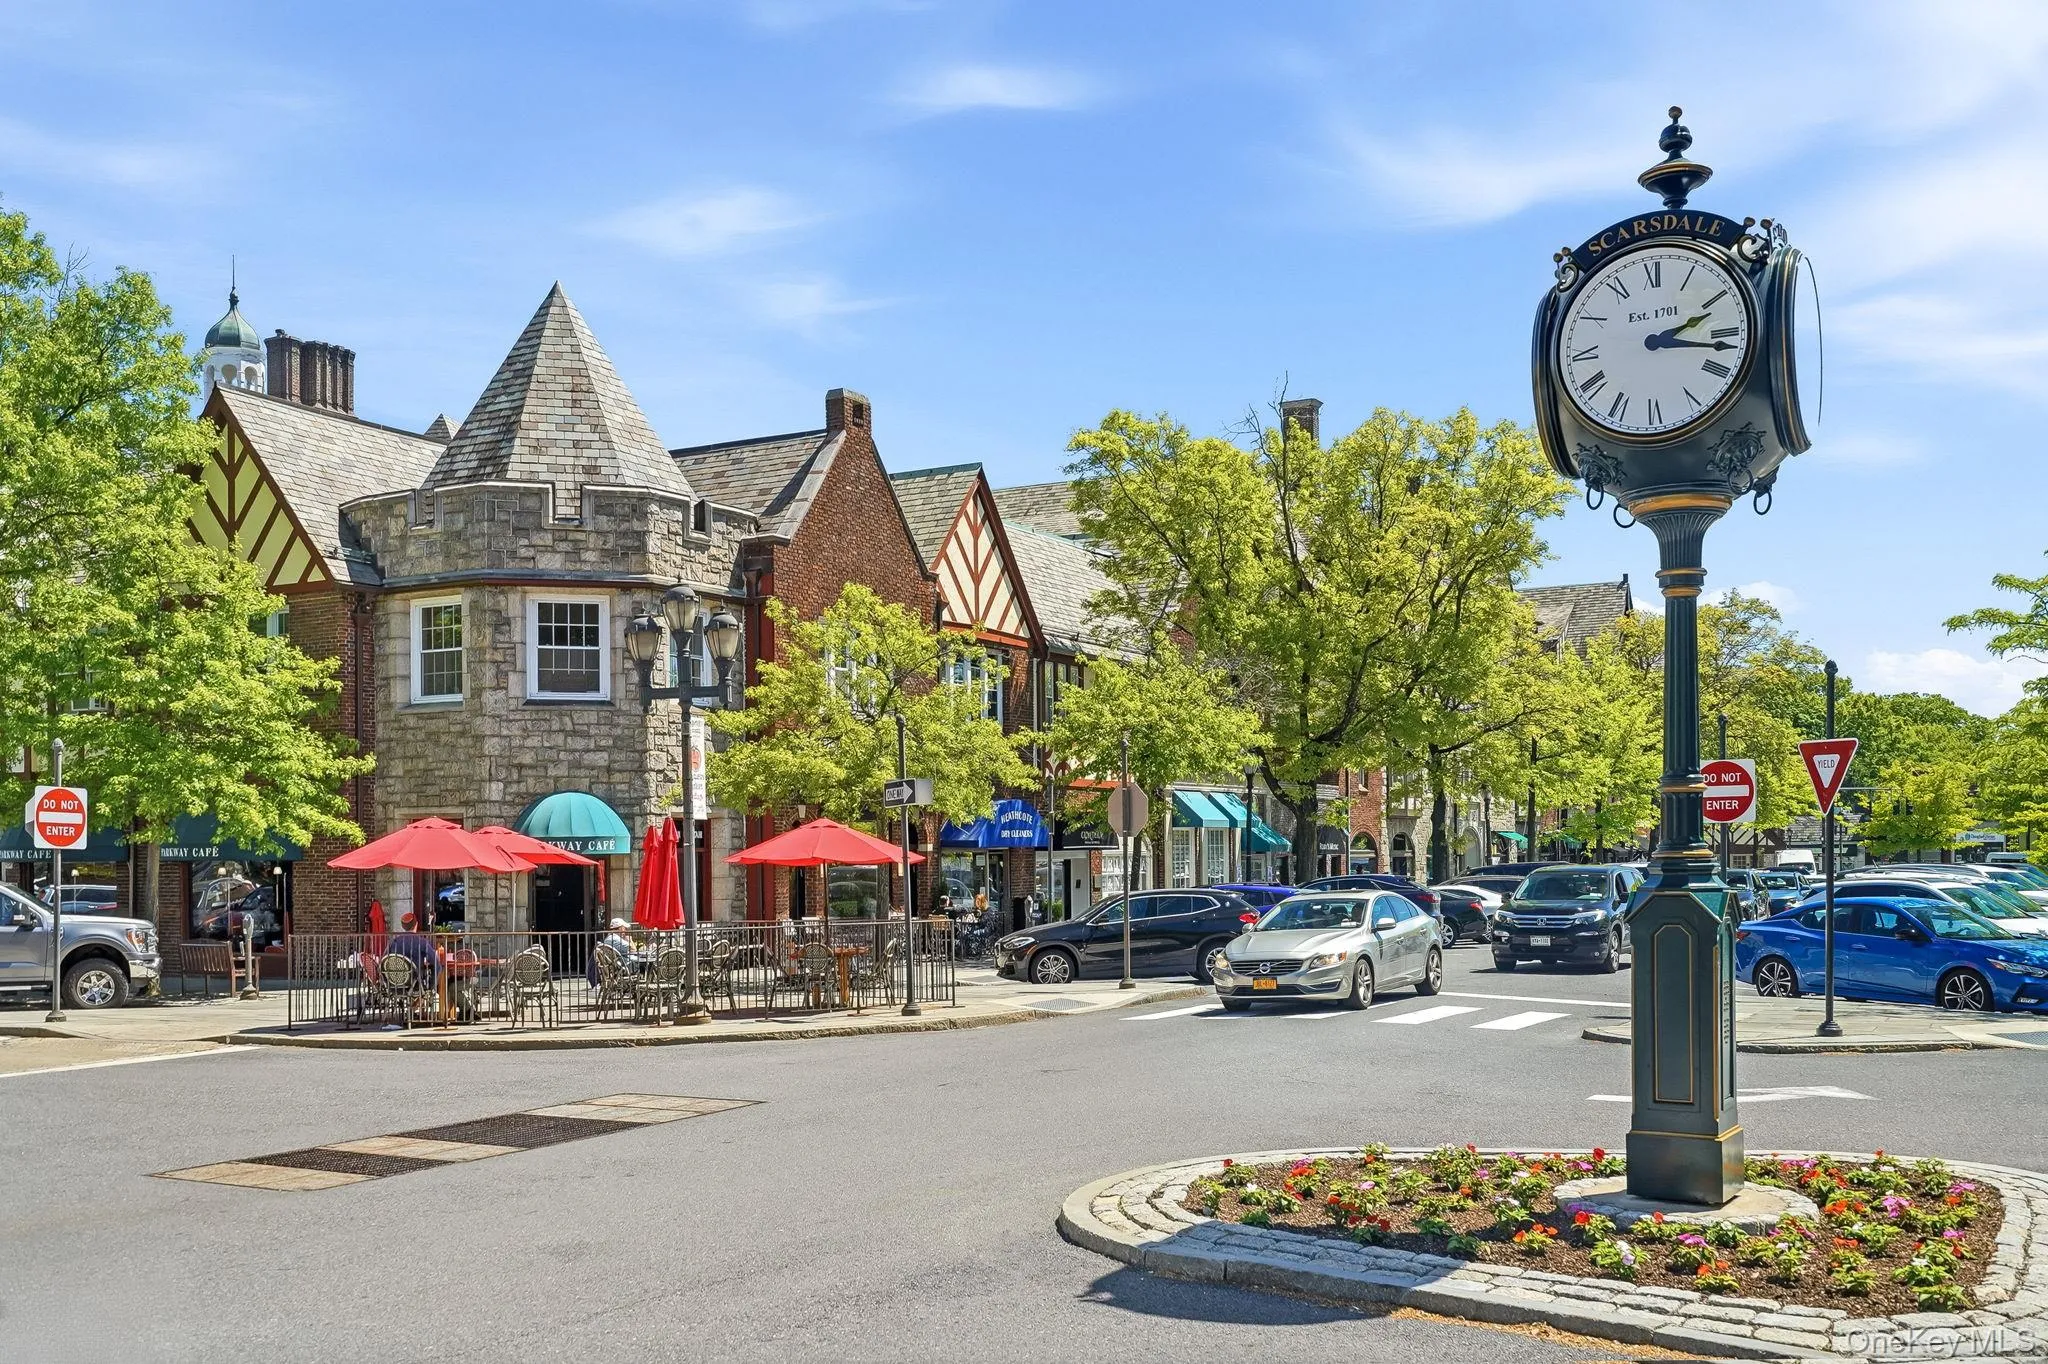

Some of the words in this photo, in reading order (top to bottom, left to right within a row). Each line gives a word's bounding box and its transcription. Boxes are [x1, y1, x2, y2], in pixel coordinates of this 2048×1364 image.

[1588, 214, 1726, 257] SCARSDALE
[1643, 261, 1661, 291] XII
[1680, 265, 1695, 291] I
[1606, 276, 1630, 305] XI
[1701, 289, 1728, 310] II
[1579, 309, 1608, 328] X
[1628, 312, 1650, 323] Est.
[1654, 305, 1679, 319] 1701
[1711, 326, 1739, 339] III
[1607, 391, 1630, 422] VII
[1683, 386, 1701, 412] V
[1817, 759, 1836, 769] YIELD
[1703, 773, 1717, 783] DO
[1721, 772, 1742, 783] NOT
[43, 799, 56, 809] DO
[61, 800, 79, 810] NOT
[1706, 800, 1739, 810] ENTER
[46, 826, 75, 836] ENTER
[192, 846, 219, 858] CAFÉ
[549, 841, 582, 851] KWAY
[588, 839, 616, 851] CAFÉ
